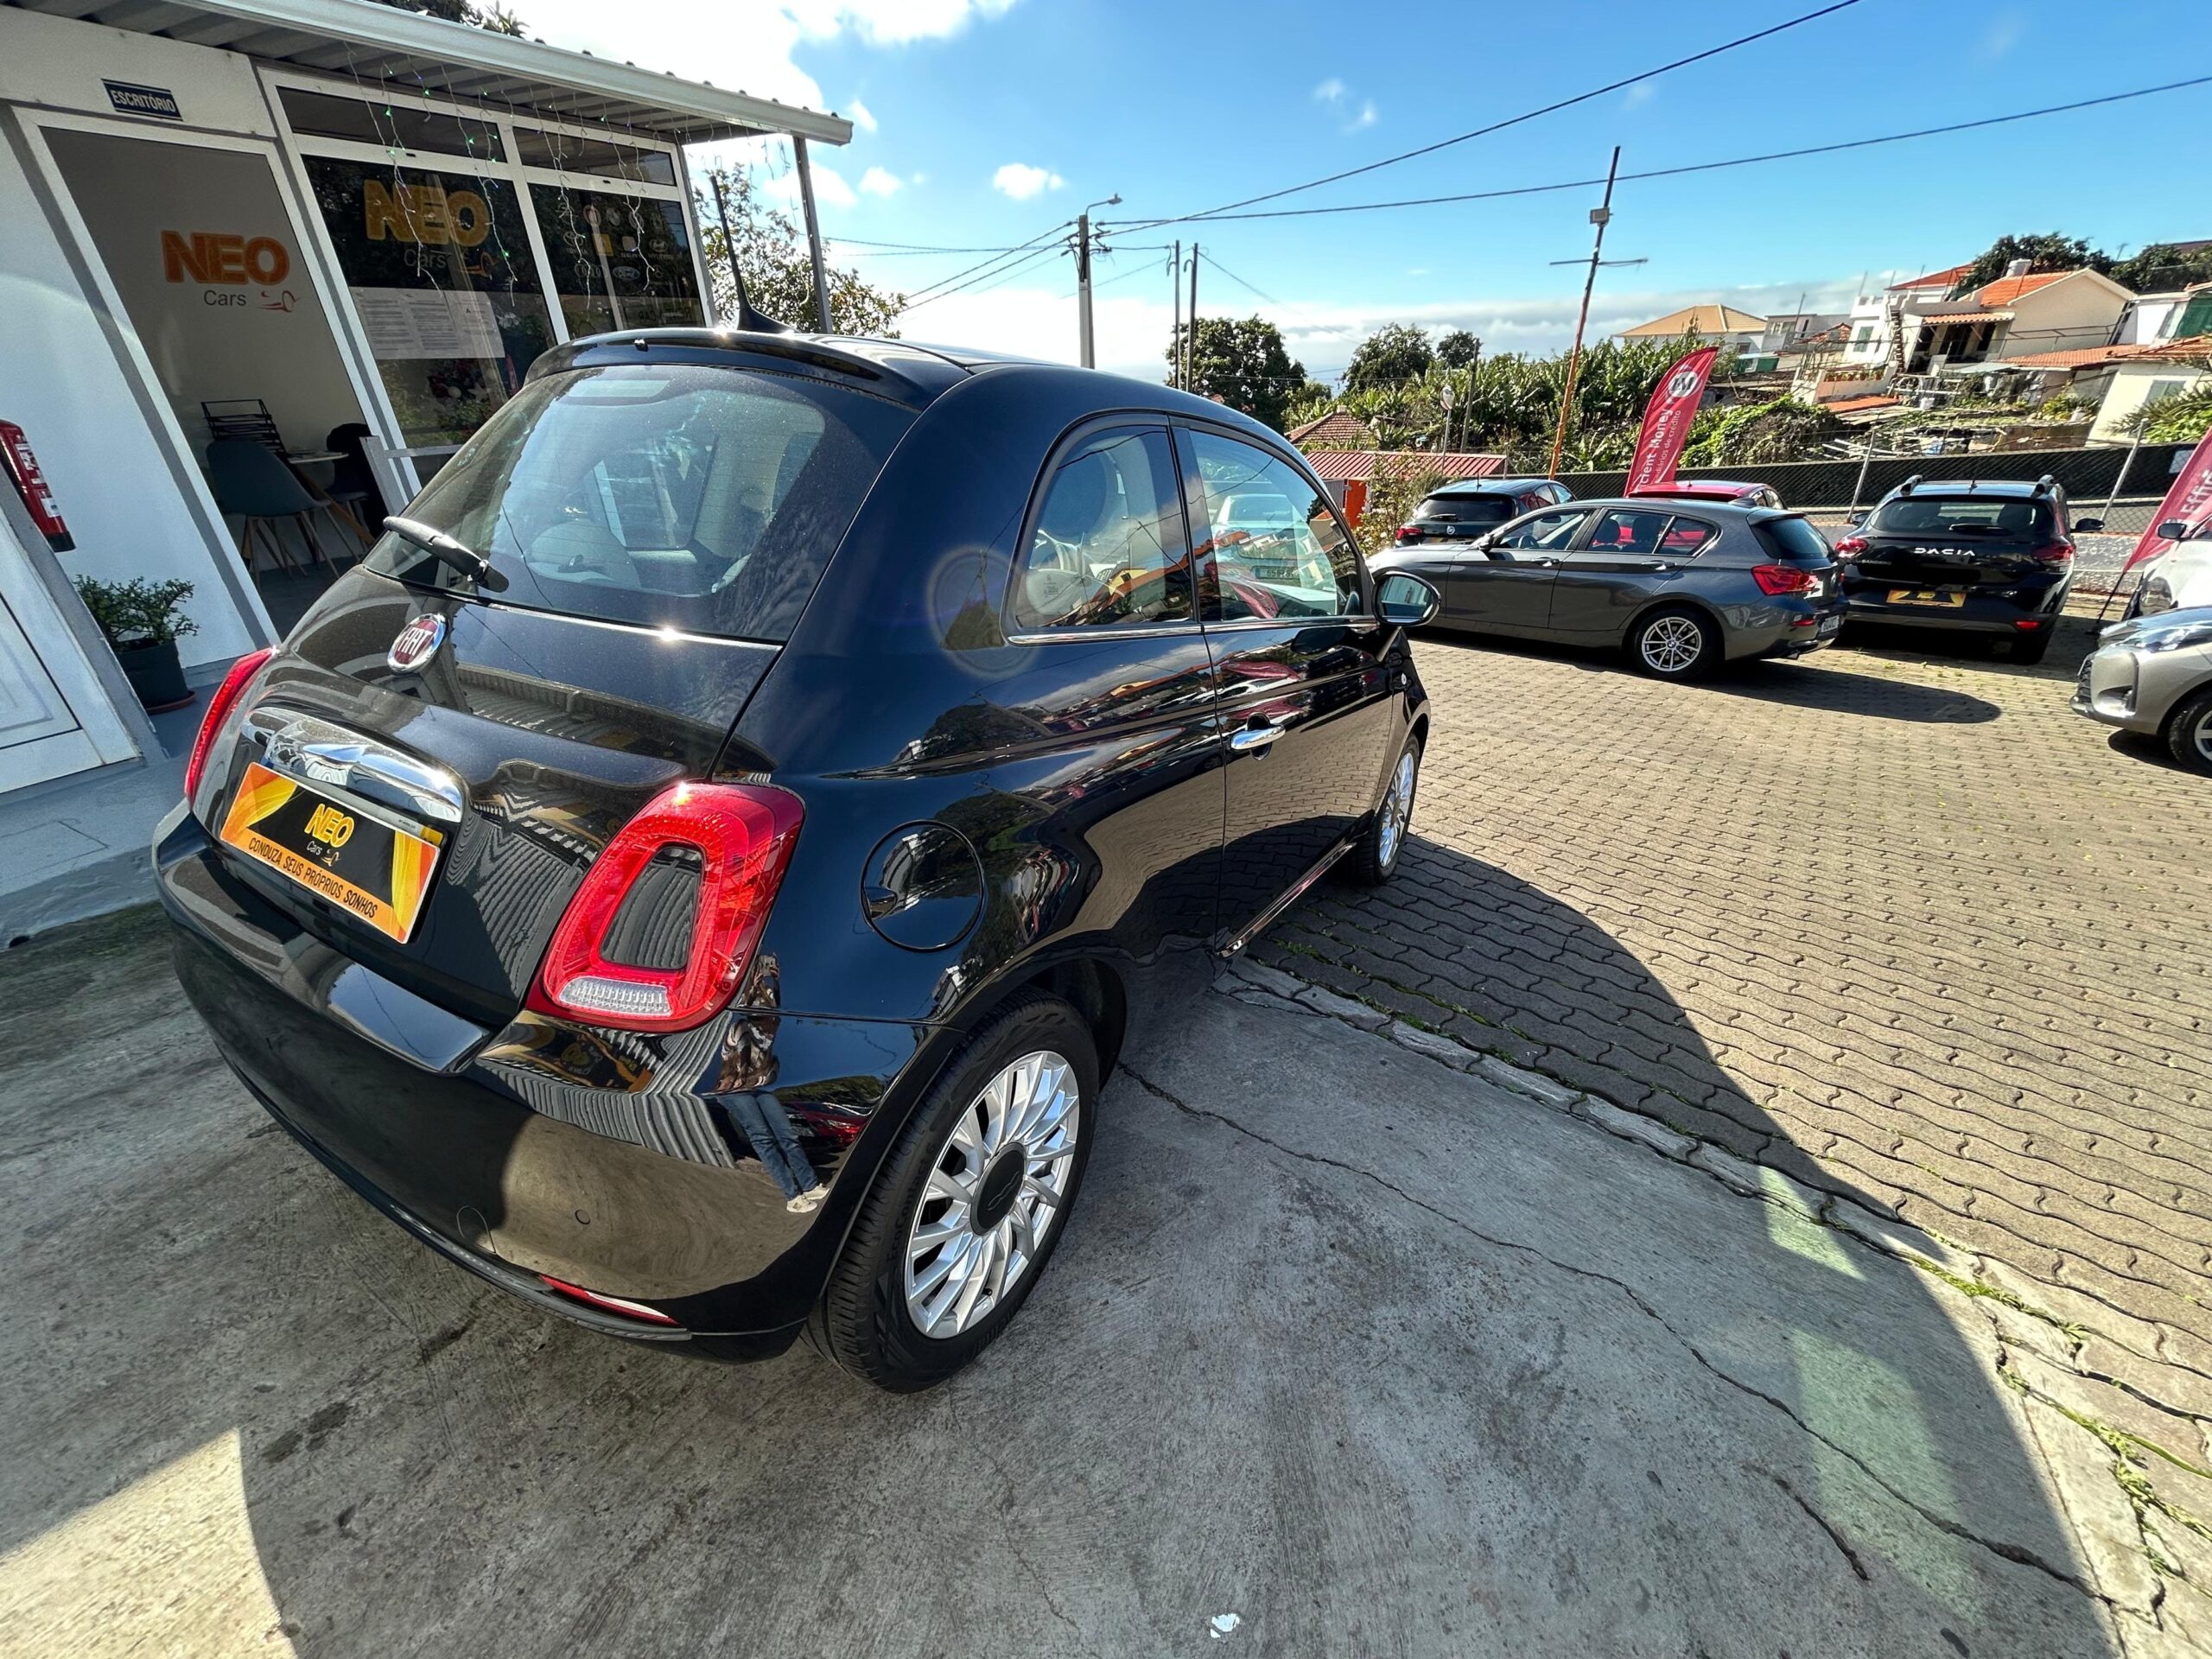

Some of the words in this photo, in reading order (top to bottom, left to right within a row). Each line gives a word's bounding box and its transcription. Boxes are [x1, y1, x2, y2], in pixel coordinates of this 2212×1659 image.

[110, 89, 176, 112] ESCRITÓRIO
[364, 179, 490, 247] NEO
[161, 229, 290, 286] NEO
[404, 249, 447, 269] Cars
[203, 289, 247, 307] Cars
[1649, 409, 1673, 448] Money
[1914, 547, 1975, 556] DACIA
[397, 626, 434, 657] FIAT
[304, 803, 355, 848] NEO
[306, 840, 321, 855] Cars
[248, 836, 283, 865] CONDUZA
[283, 855, 304, 876] SEUS
[303, 866, 344, 899] PRÓPRIOS
[343, 890, 378, 918] SONHOS
